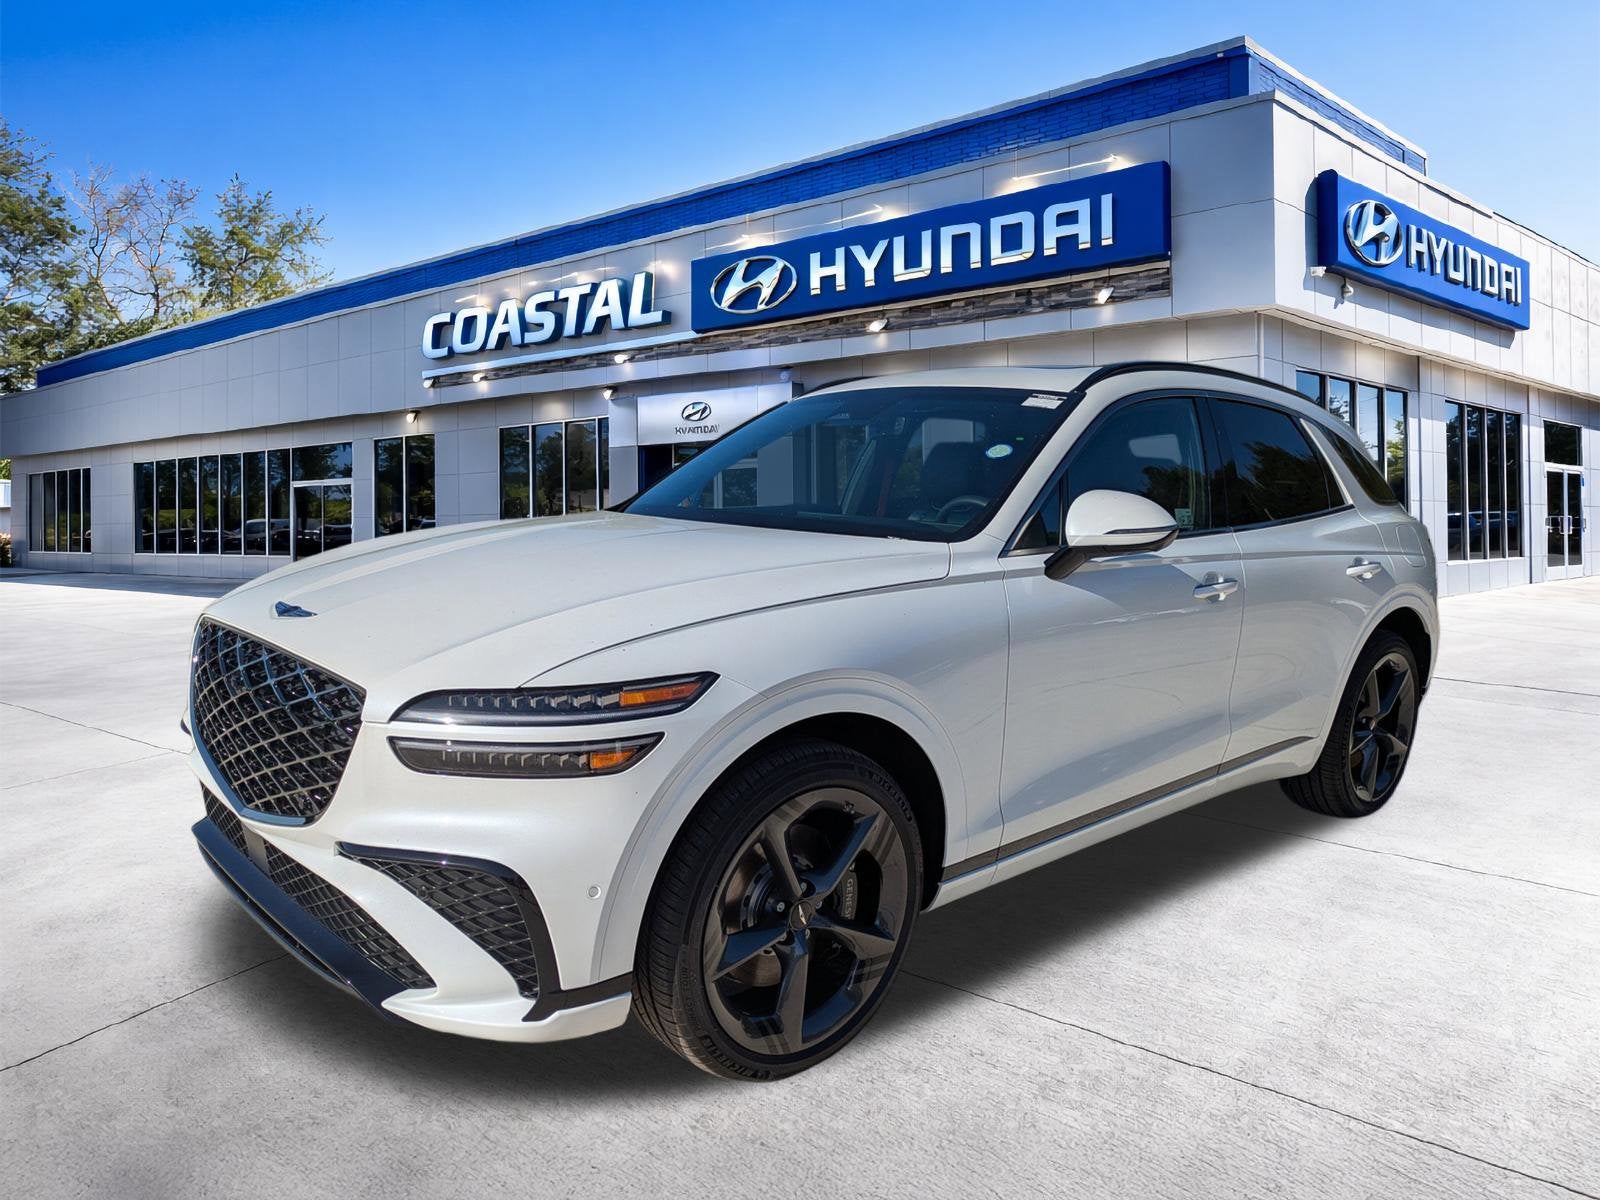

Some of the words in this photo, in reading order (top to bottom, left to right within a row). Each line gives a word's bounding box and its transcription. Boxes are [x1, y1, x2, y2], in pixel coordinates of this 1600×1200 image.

[809, 192, 1114, 296] HYUNDAI
[1405, 224, 1522, 306] HYUNDAI
[422, 271, 672, 359] COASTAL
